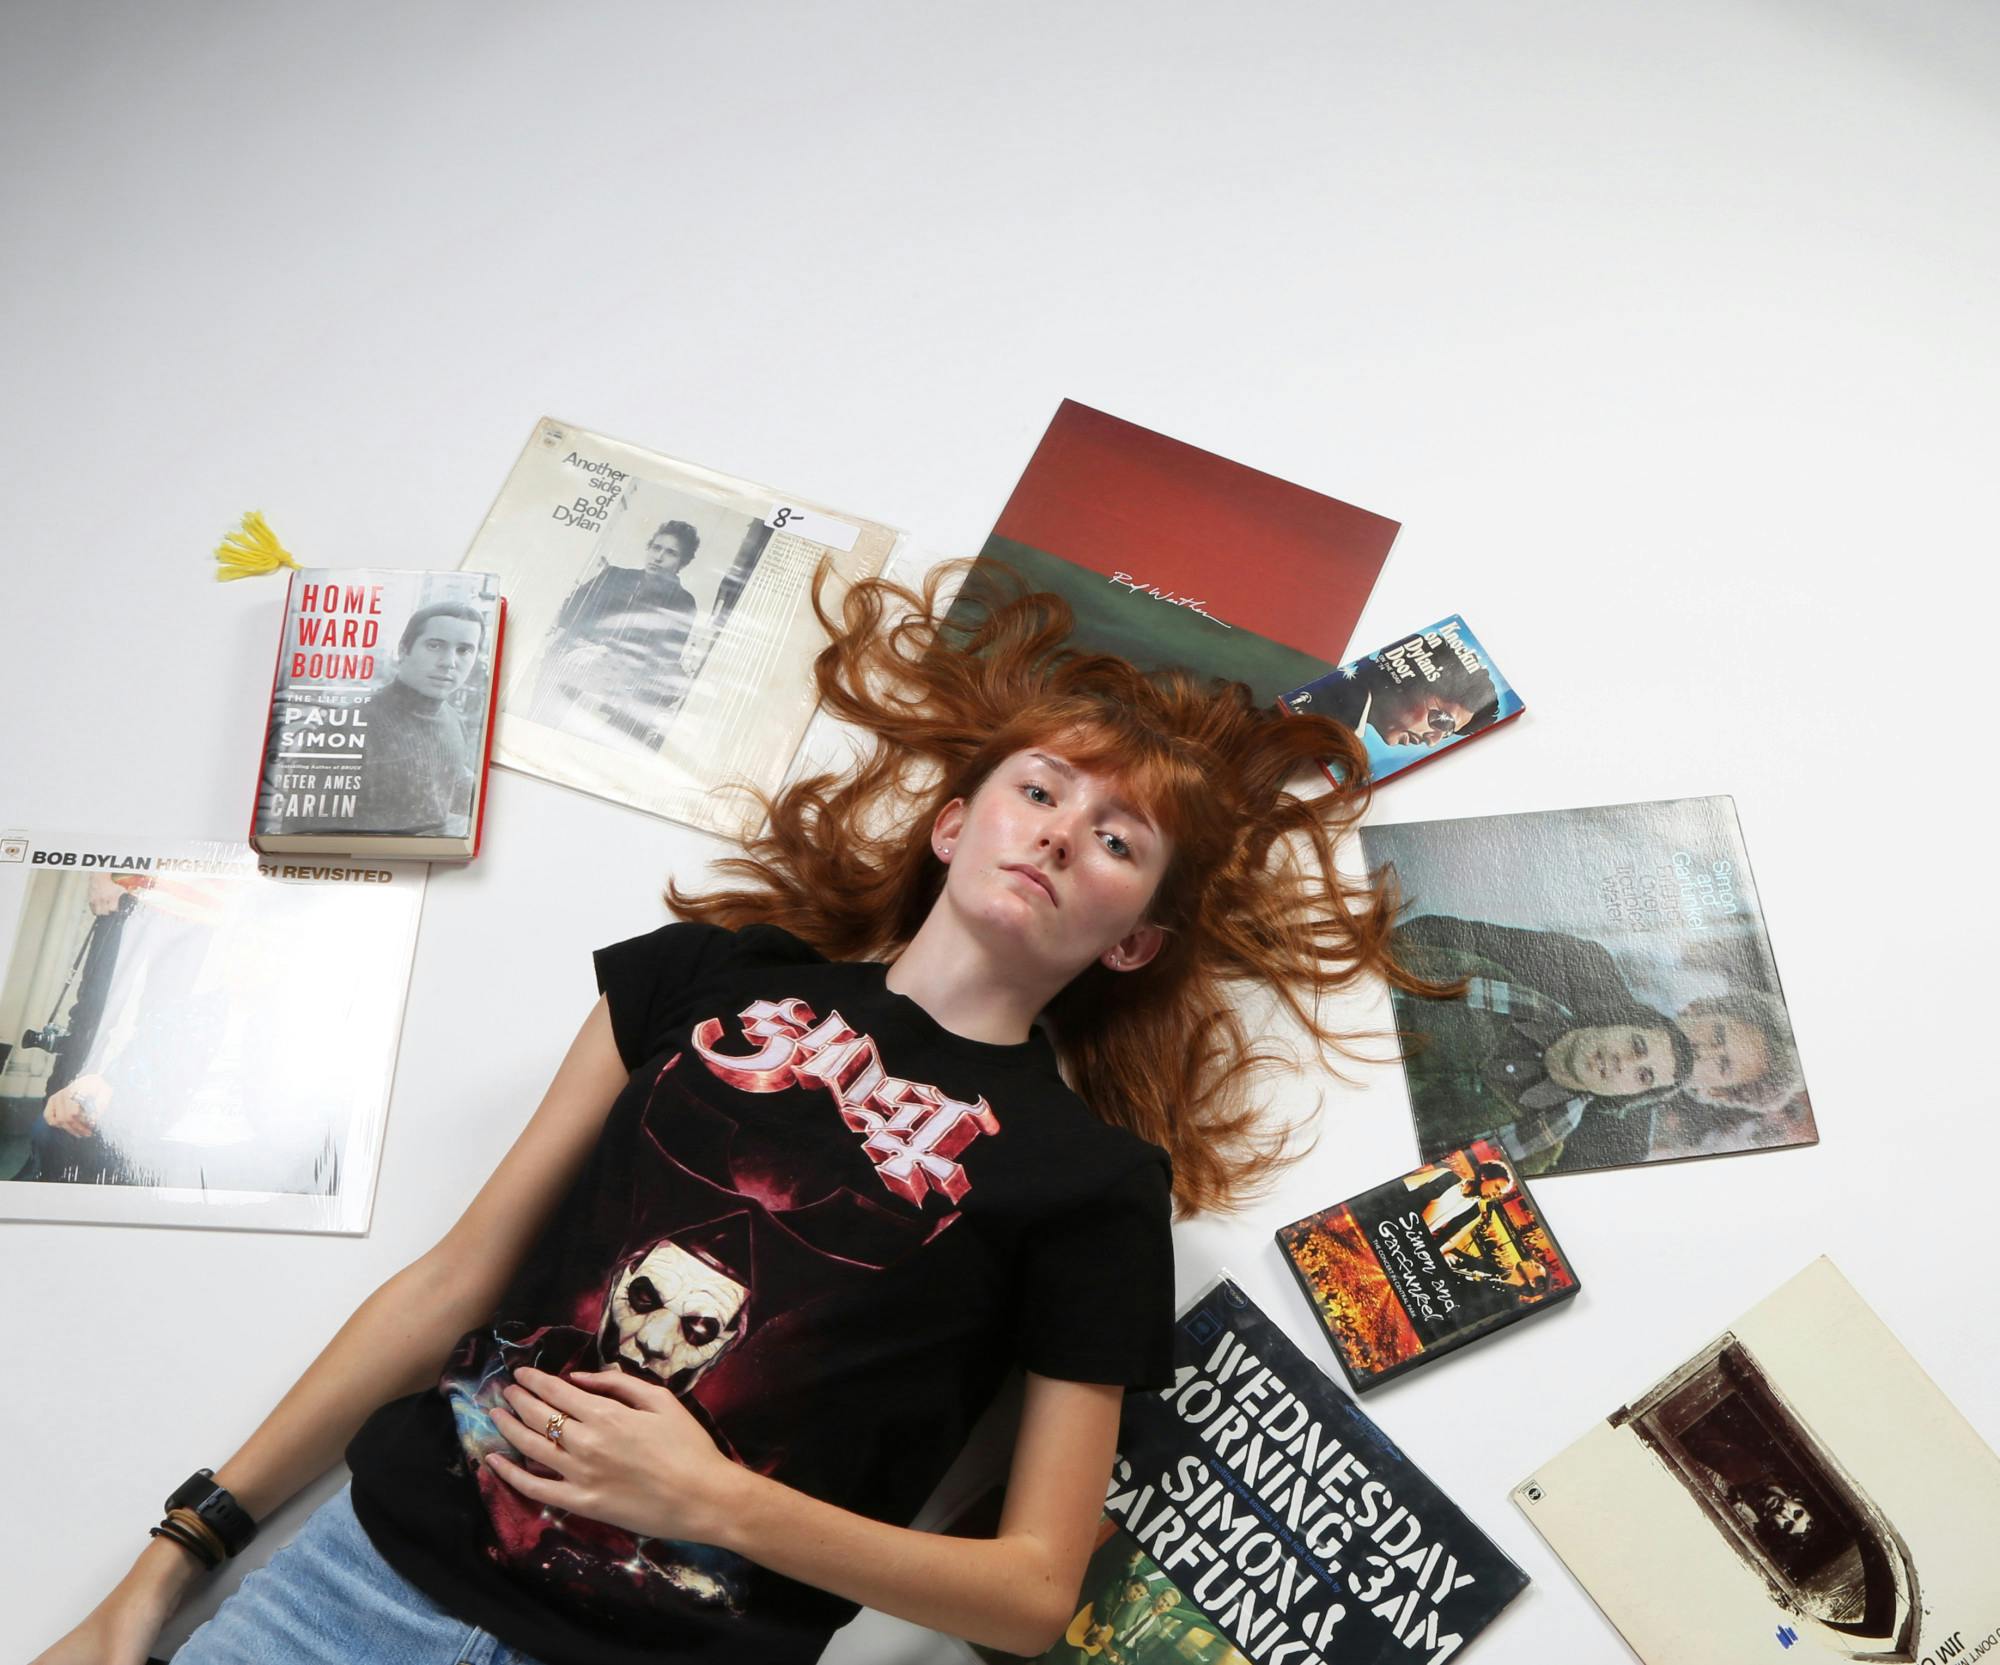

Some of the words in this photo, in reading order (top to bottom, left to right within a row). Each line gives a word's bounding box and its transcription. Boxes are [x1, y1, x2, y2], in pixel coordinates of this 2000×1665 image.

[562, 452, 630, 482] Another
[588, 476, 622, 495] side
[595, 492, 620, 508] of
[552, 505, 602, 533] Dylan
[573, 497, 609, 521] Bob
[301, 584, 384, 615] HOME
[299, 617, 379, 648] WARD
[1424, 631, 1444, 650] on
[1439, 621, 1488, 675] Knockin'
[290, 652, 375, 680] BOUND
[1384, 645, 1416, 679] Door
[1404, 636, 1444, 683] Dylan's
[287, 694, 312, 704] THE
[318, 695, 349, 704] LIFE
[353, 696, 372, 704] OF
[285, 707, 368, 727] PAUL
[281, 732, 366, 748] SIMON
[274, 774, 317, 790] PETER
[323, 775, 362, 790] AMES
[270, 793, 357, 818] CARLIN
[32, 850, 77, 866] BOB
[81, 854, 151, 870] DYLAN
[282, 865, 393, 883] REVISITED
[1672, 851, 1709, 930] Garfunkel
[1697, 874, 1721, 908] and
[1713, 860, 1737, 914] Simon
[1373, 1239, 1381, 1250] THE
[1379, 1250, 1395, 1275] CONCERT
[1394, 1281, 1410, 1305] CENTRAL
[1406, 1303, 1417, 1318] PARK
[1379, 1221, 1444, 1322] Garfunkel
[1399, 1212, 1436, 1275] Simon
[1432, 1280, 1456, 1313] and
[1204, 1330, 1475, 1604] WEDNESDAY
[1162, 1456, 1318, 1613] SIMON
[1210, 1459, 1236, 1488] exciting
[1234, 1484, 1249, 1500] new
[1248, 1499, 1273, 1523] sounds
[1279, 1528, 1293, 1541] the
[1291, 1540, 1307, 1557] folk
[1304, 1555, 1334, 1585] tradition
[1332, 1581, 1343, 1593] by
[1935, 1631, 1966, 1664] JIM
